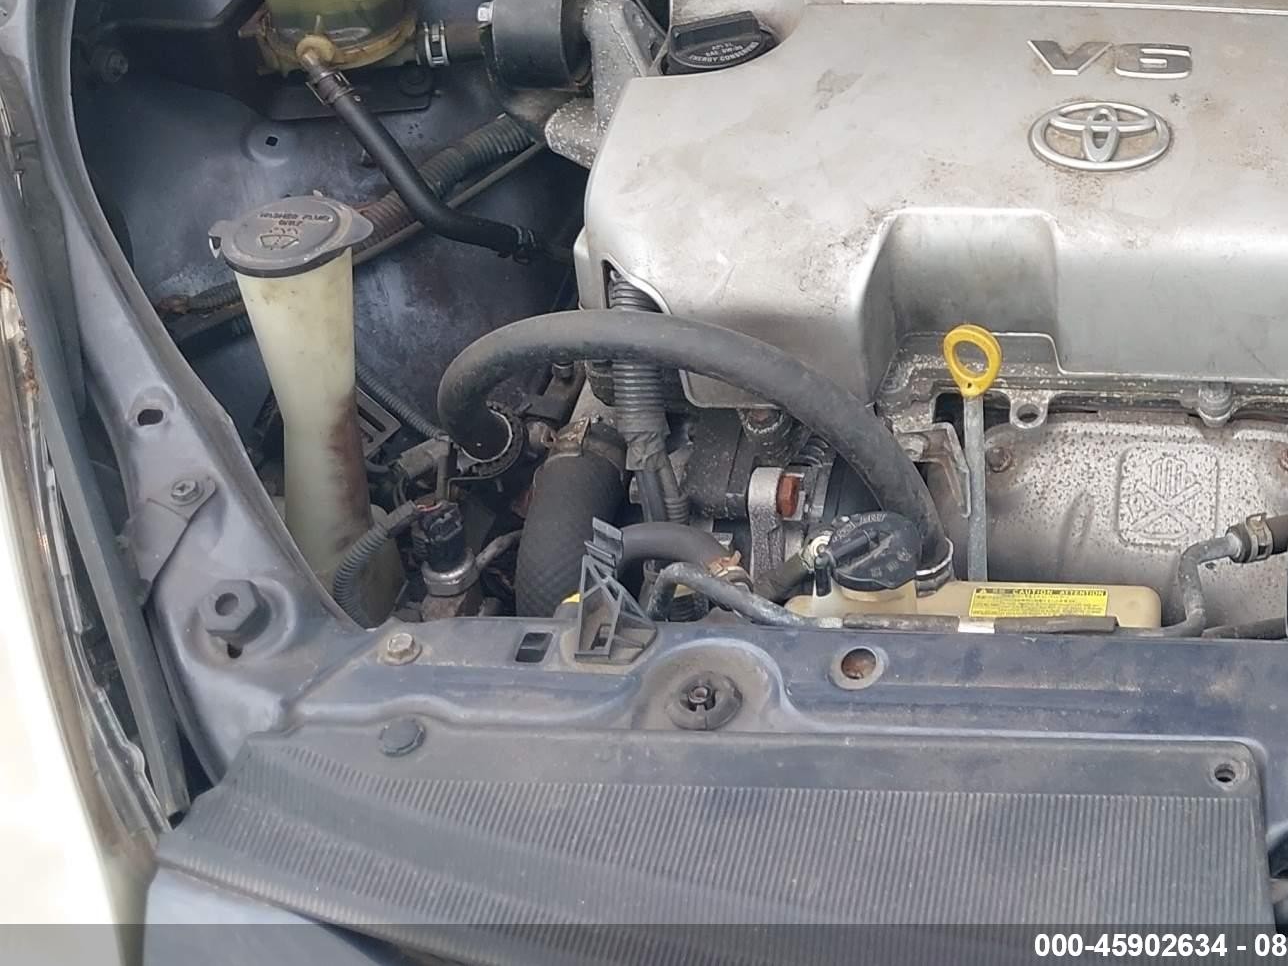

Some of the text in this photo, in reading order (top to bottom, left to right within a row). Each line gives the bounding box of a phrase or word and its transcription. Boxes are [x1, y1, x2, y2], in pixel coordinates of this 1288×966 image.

[688, 54, 719, 63] ENERGY
[1027, 39, 1193, 81] V6
[1013, 588, 1053, 596] CAUTION
